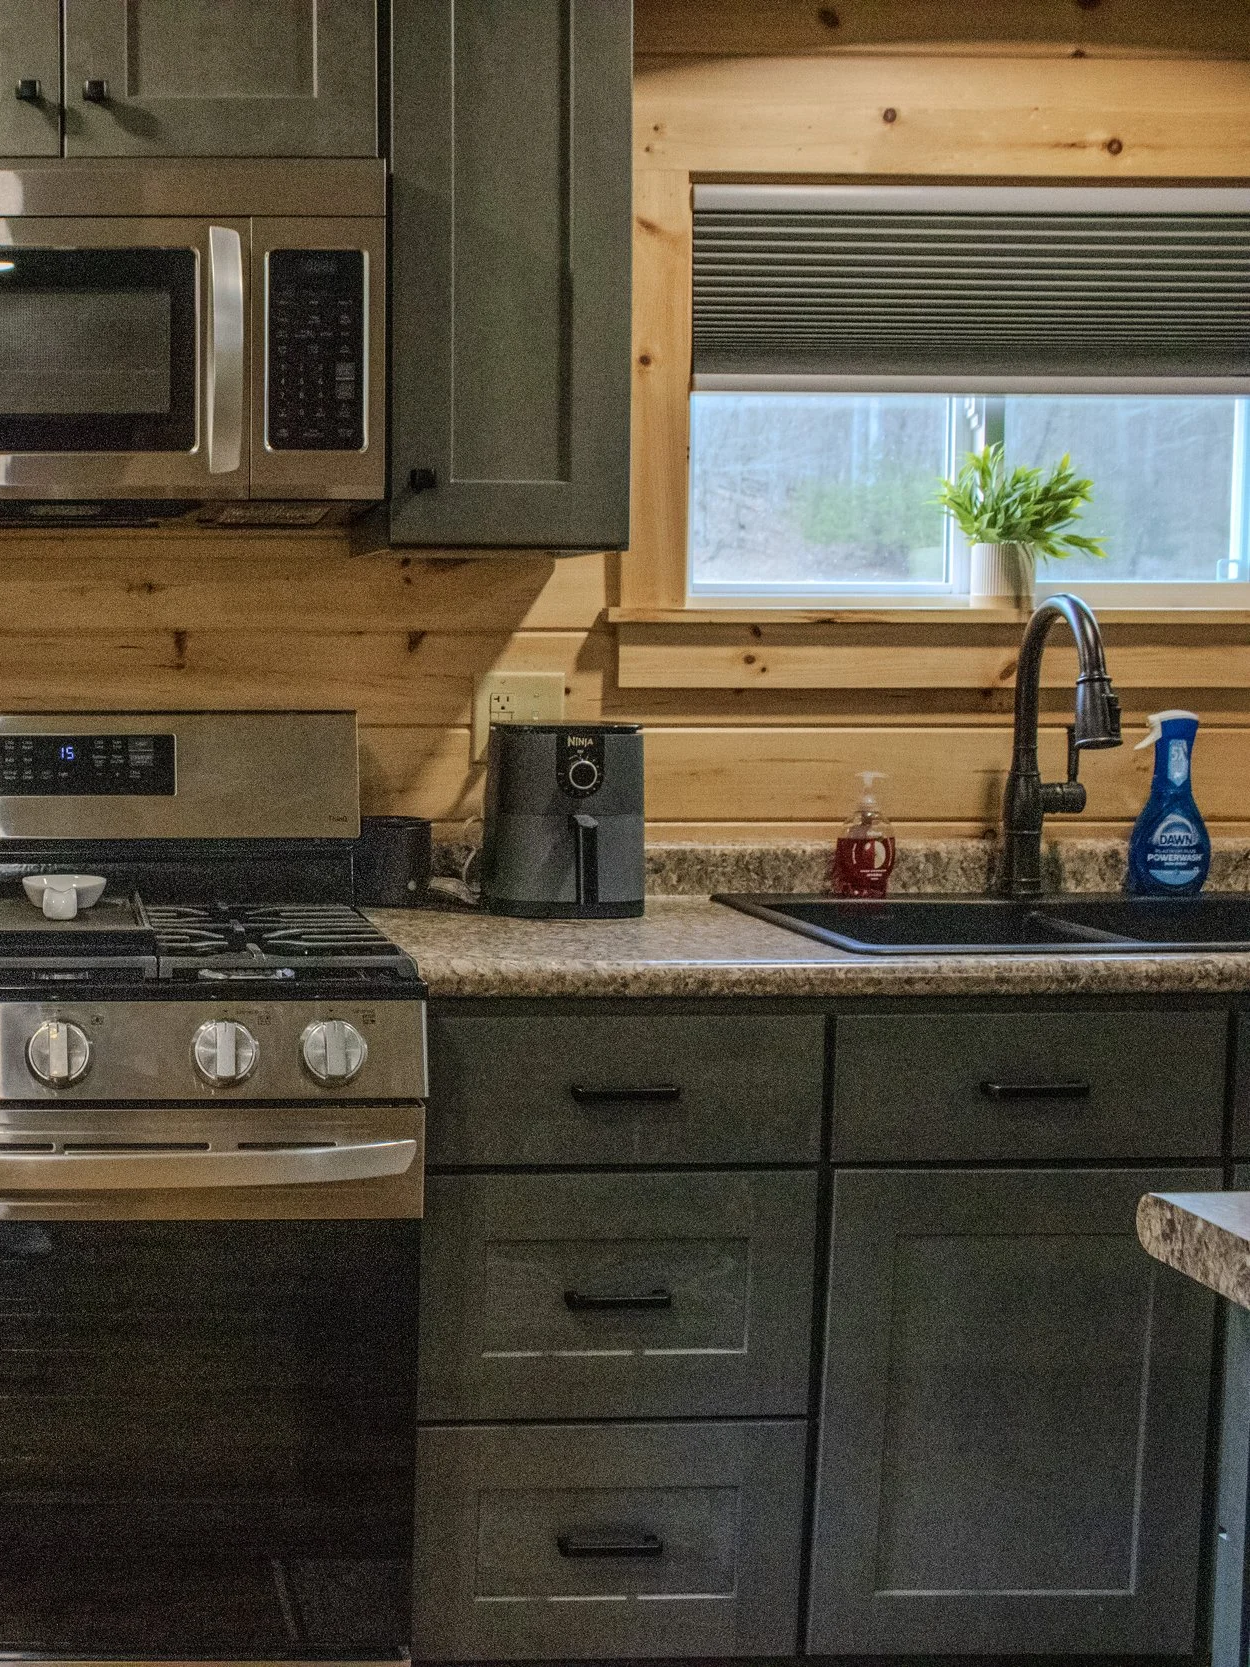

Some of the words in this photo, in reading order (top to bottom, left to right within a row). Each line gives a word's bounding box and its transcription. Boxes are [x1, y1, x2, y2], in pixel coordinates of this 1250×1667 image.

[60, 746, 75, 760] 15
[1159, 834, 1193, 846] DAWN
[1146, 853, 1202, 862] POWERWASH
